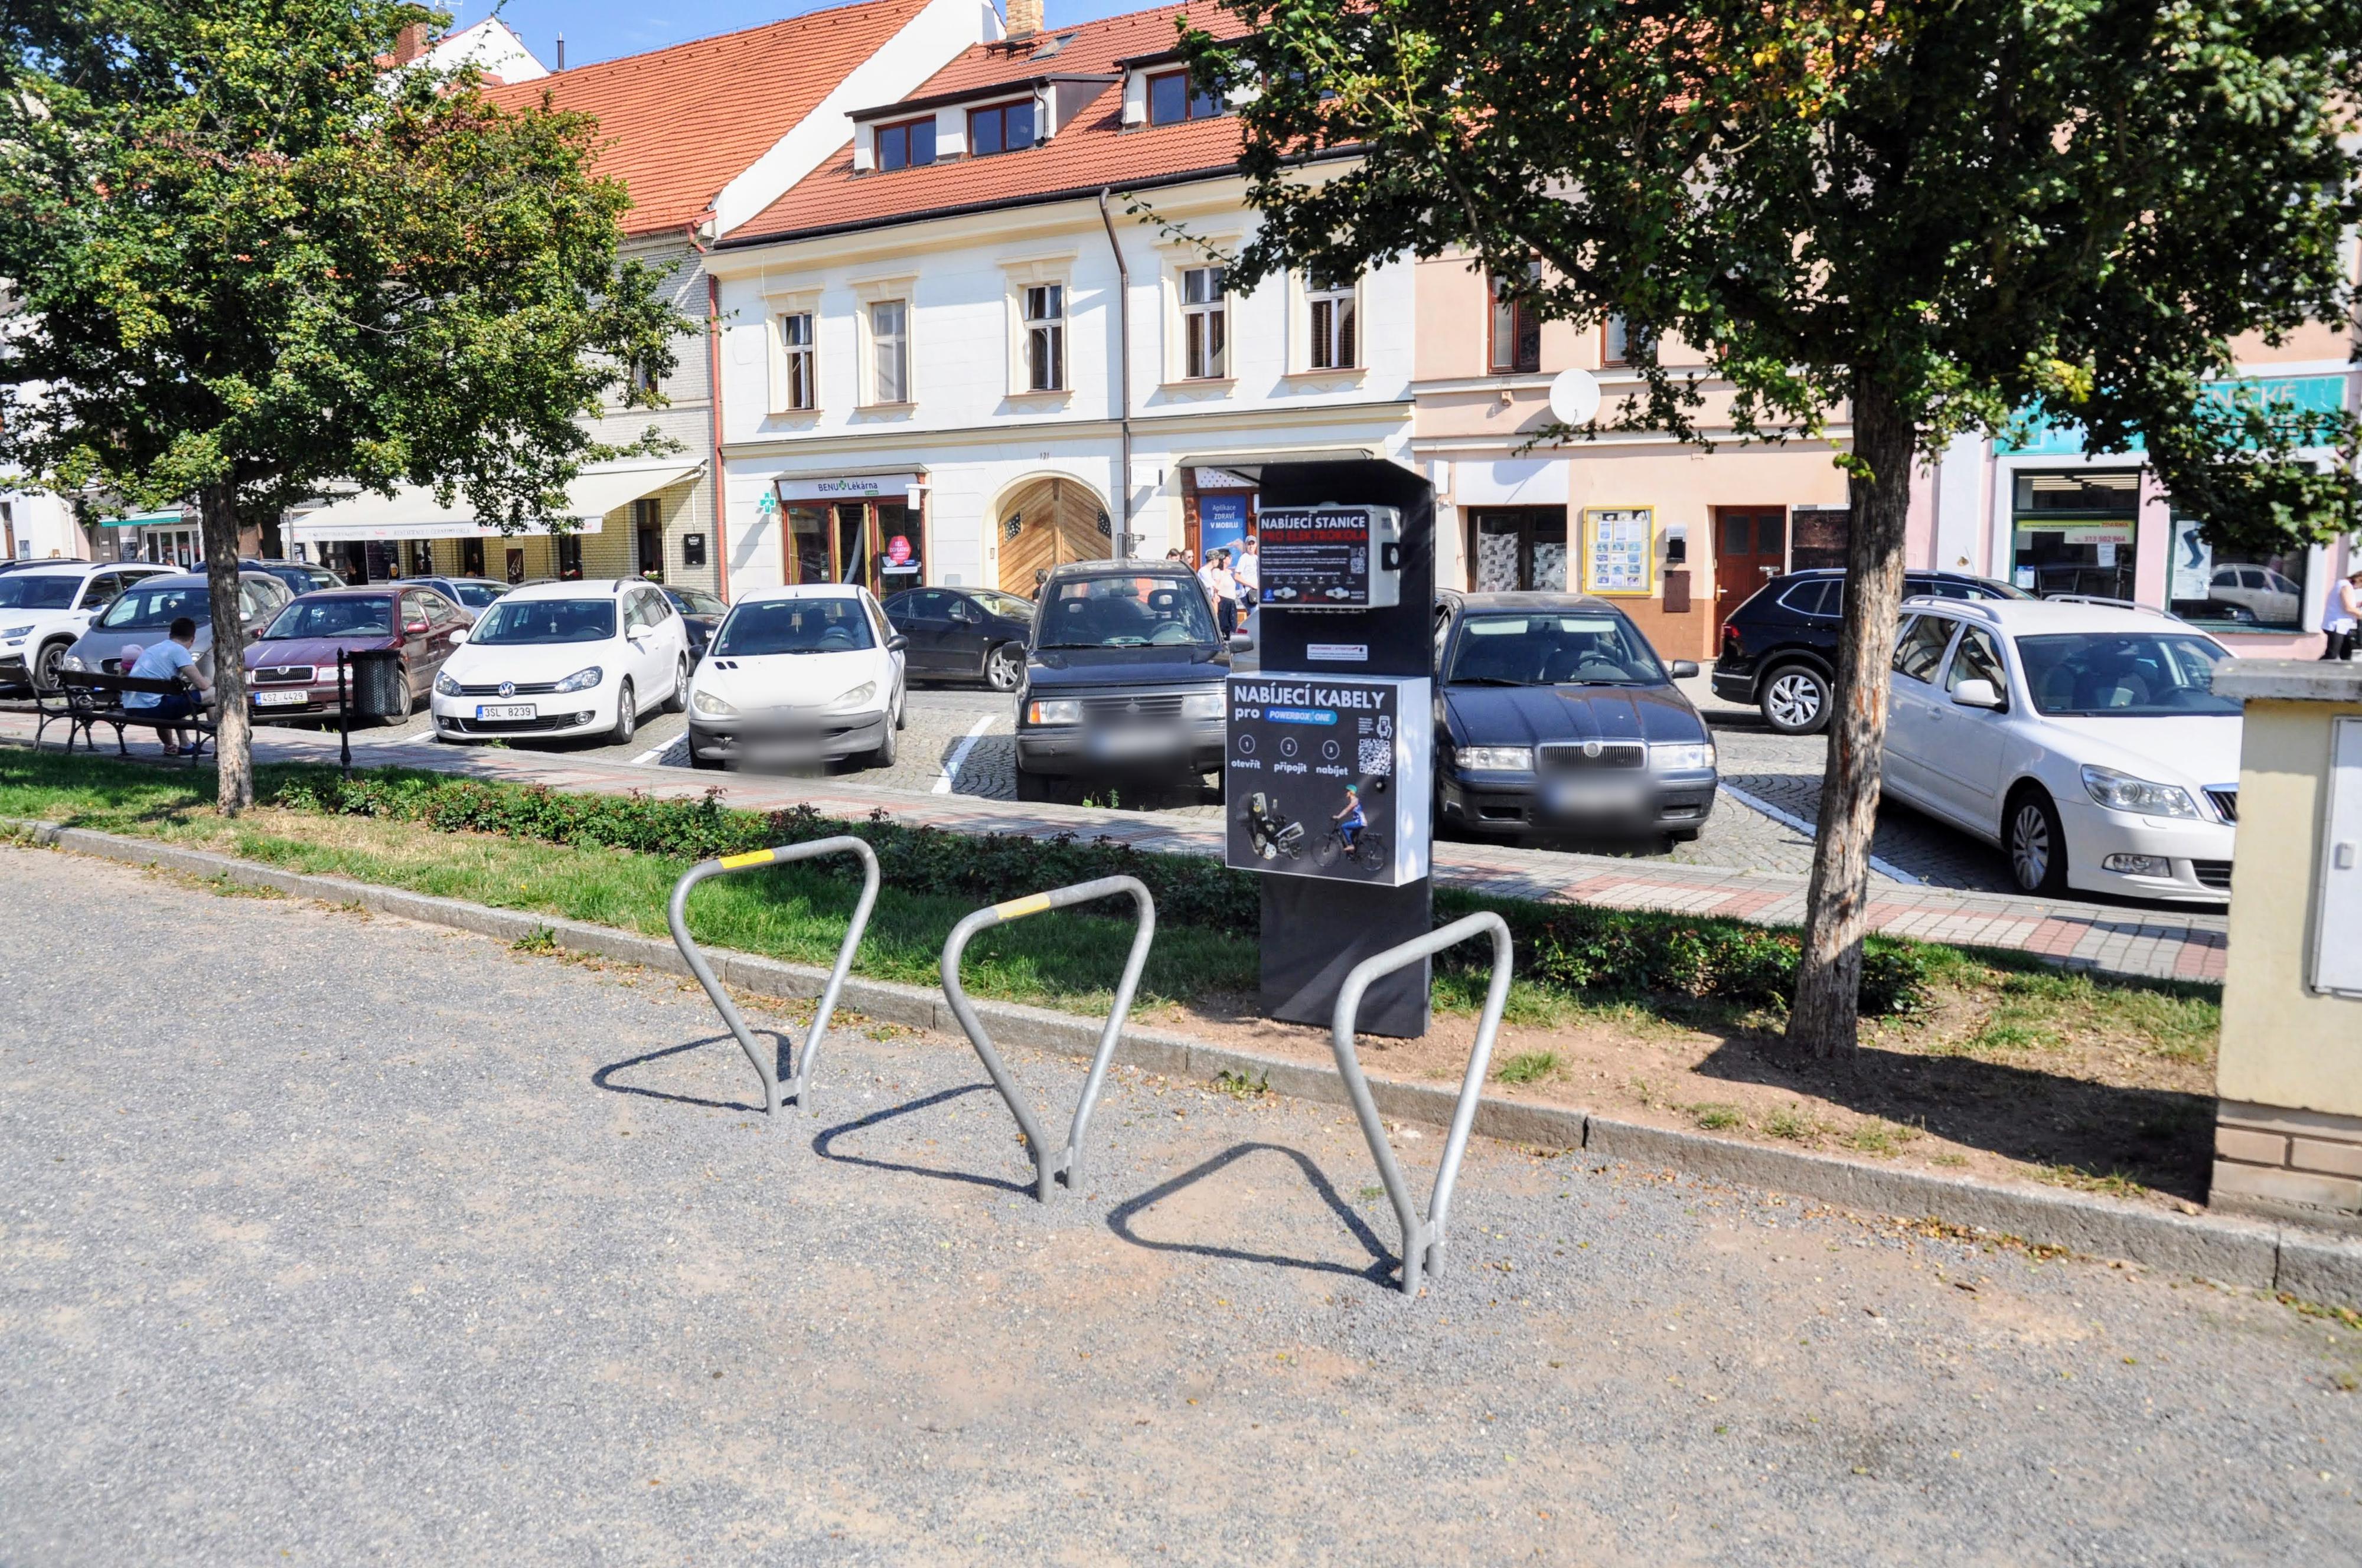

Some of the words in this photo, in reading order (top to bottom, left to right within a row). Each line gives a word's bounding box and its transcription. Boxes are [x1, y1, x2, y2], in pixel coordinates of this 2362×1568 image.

[818, 483, 839, 491] BENU
[847, 481, 878, 490] Lékárna
[1261, 514, 1312, 529] NABÍJECÍ
[1314, 517, 1365, 528] STANICE
[1261, 530, 1284, 541] PRO
[1287, 529, 1368, 541] ELEKTROKOLA
[1234, 682, 1311, 705] NABÍJECÍ
[1315, 689, 1385, 709] KABELY
[485, 708, 501, 717] 3SL
[508, 707, 530, 716] 8239
[1235, 707, 1260, 721] pro
[1231, 759, 1261, 769] otevřít
[1274, 762, 1307, 775] připojit
[1316, 765, 1349, 778] nabíjet
